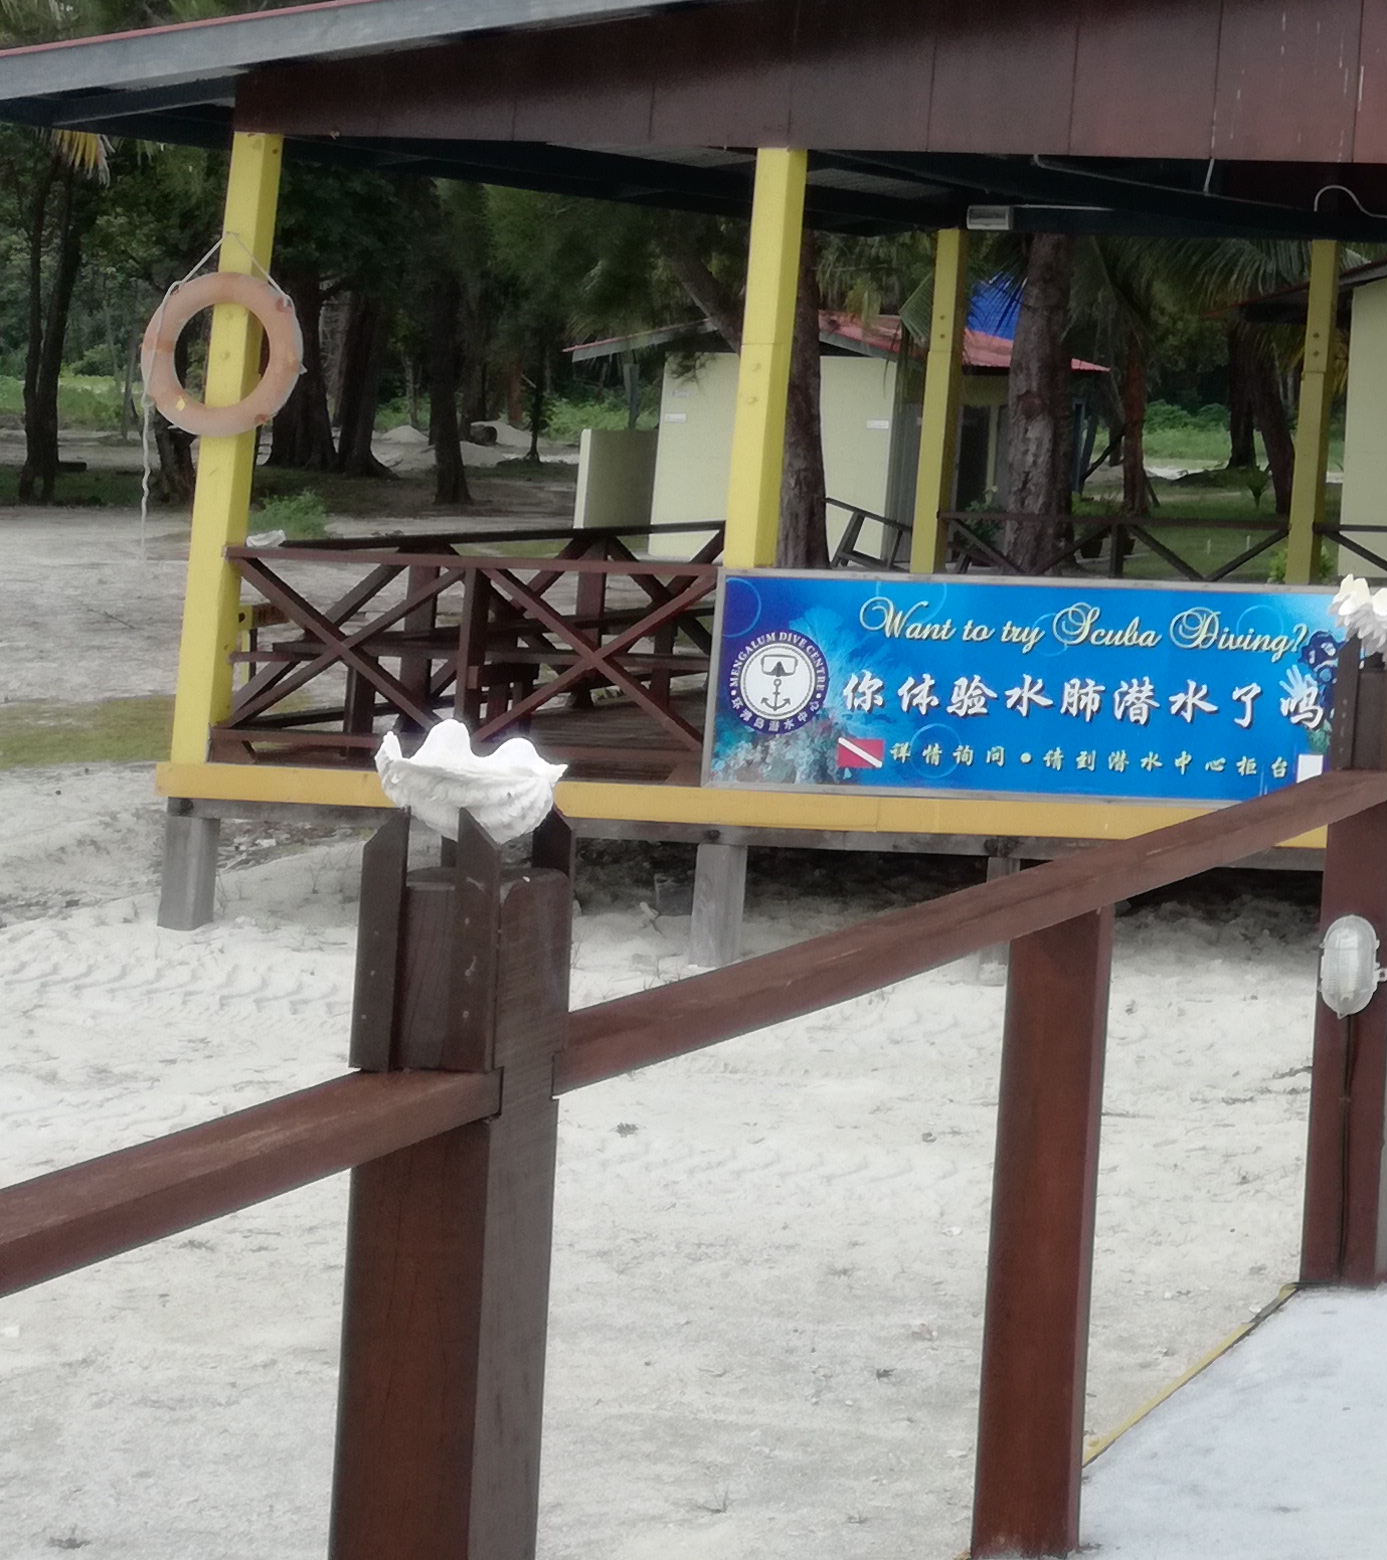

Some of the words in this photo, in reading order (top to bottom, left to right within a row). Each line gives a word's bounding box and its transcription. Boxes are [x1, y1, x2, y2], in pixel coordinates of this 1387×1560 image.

[860, 597, 957, 640] Want
[963, 620, 995, 641] to
[1001, 620, 1046, 654] try
[1053, 602, 1162, 648] Scuba
[1170, 607, 1307, 663] Diving?
[729, 632, 776, 687] MENGALUM
[779, 632, 805, 647] DIVE
[806, 645, 826, 692] CENTRE
[843, 670, 1324, 729] 你体验水肺潜水了吗
